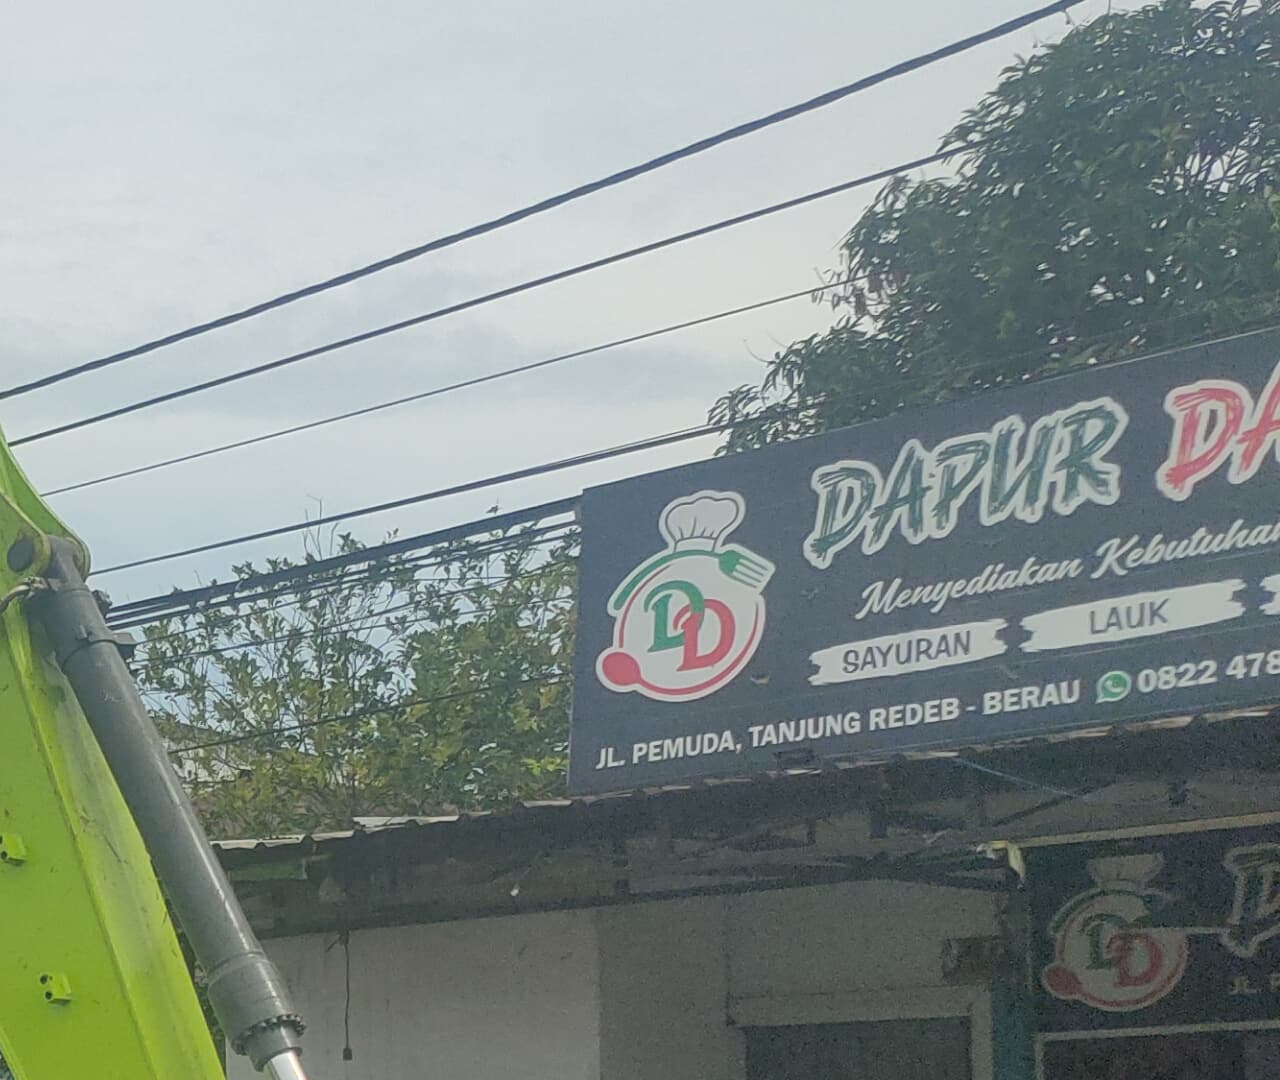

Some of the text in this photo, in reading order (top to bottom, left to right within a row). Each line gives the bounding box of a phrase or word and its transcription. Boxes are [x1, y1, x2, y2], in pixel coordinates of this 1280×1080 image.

[804, 397, 1129, 569] DAPUR
[854, 554, 1084, 620] Menyediakan
[1090, 598, 1169, 634] LAUK
[843, 630, 971, 674] SAYURAN
[595, 747, 626, 770] JL.
[632, 730, 742, 765] PEMUDA,
[749, 711, 861, 748] TANJUNG
[869, 697, 960, 731] REDEB
[982, 679, 1081, 716] BERAU
[1137, 660, 1219, 694] 0822
